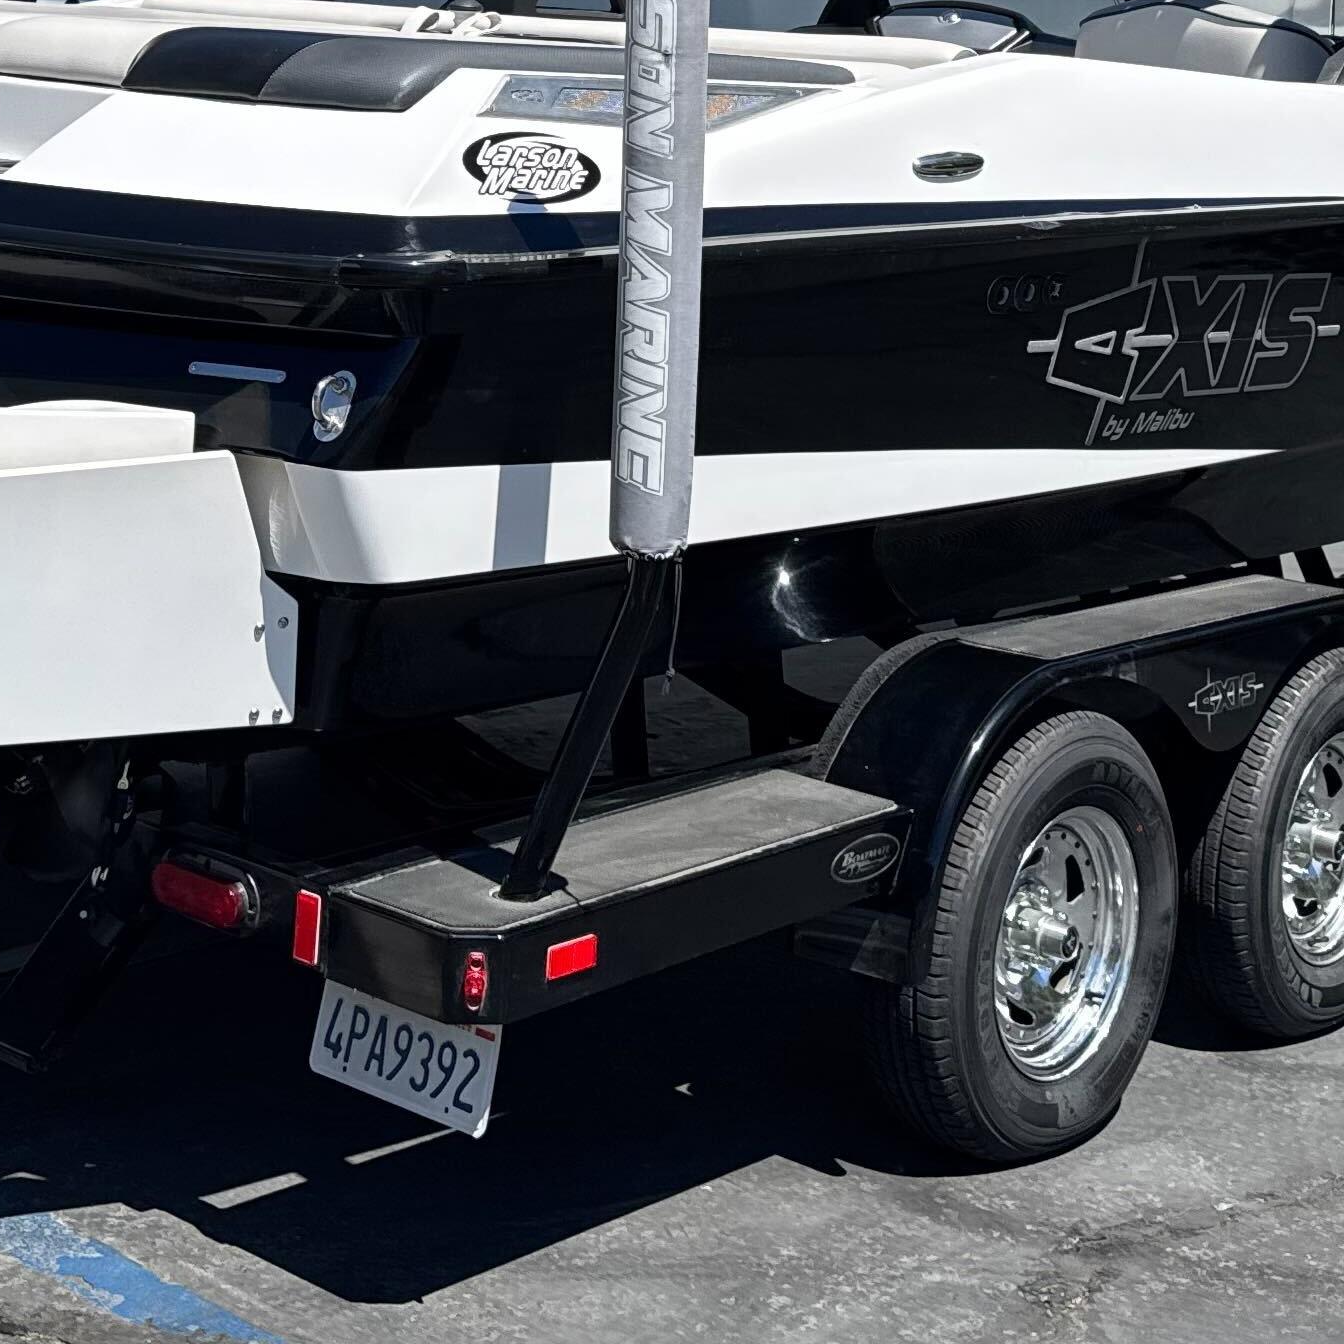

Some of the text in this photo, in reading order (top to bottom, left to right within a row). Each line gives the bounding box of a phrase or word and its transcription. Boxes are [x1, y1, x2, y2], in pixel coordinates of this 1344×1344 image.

[475, 139, 579, 169] Larson
[614, 165, 676, 497] MARINE
[1046, 272, 1332, 405] AXIS
[1102, 408, 1197, 441] by Malibu
[323, 997, 481, 1114] 4PA9392
